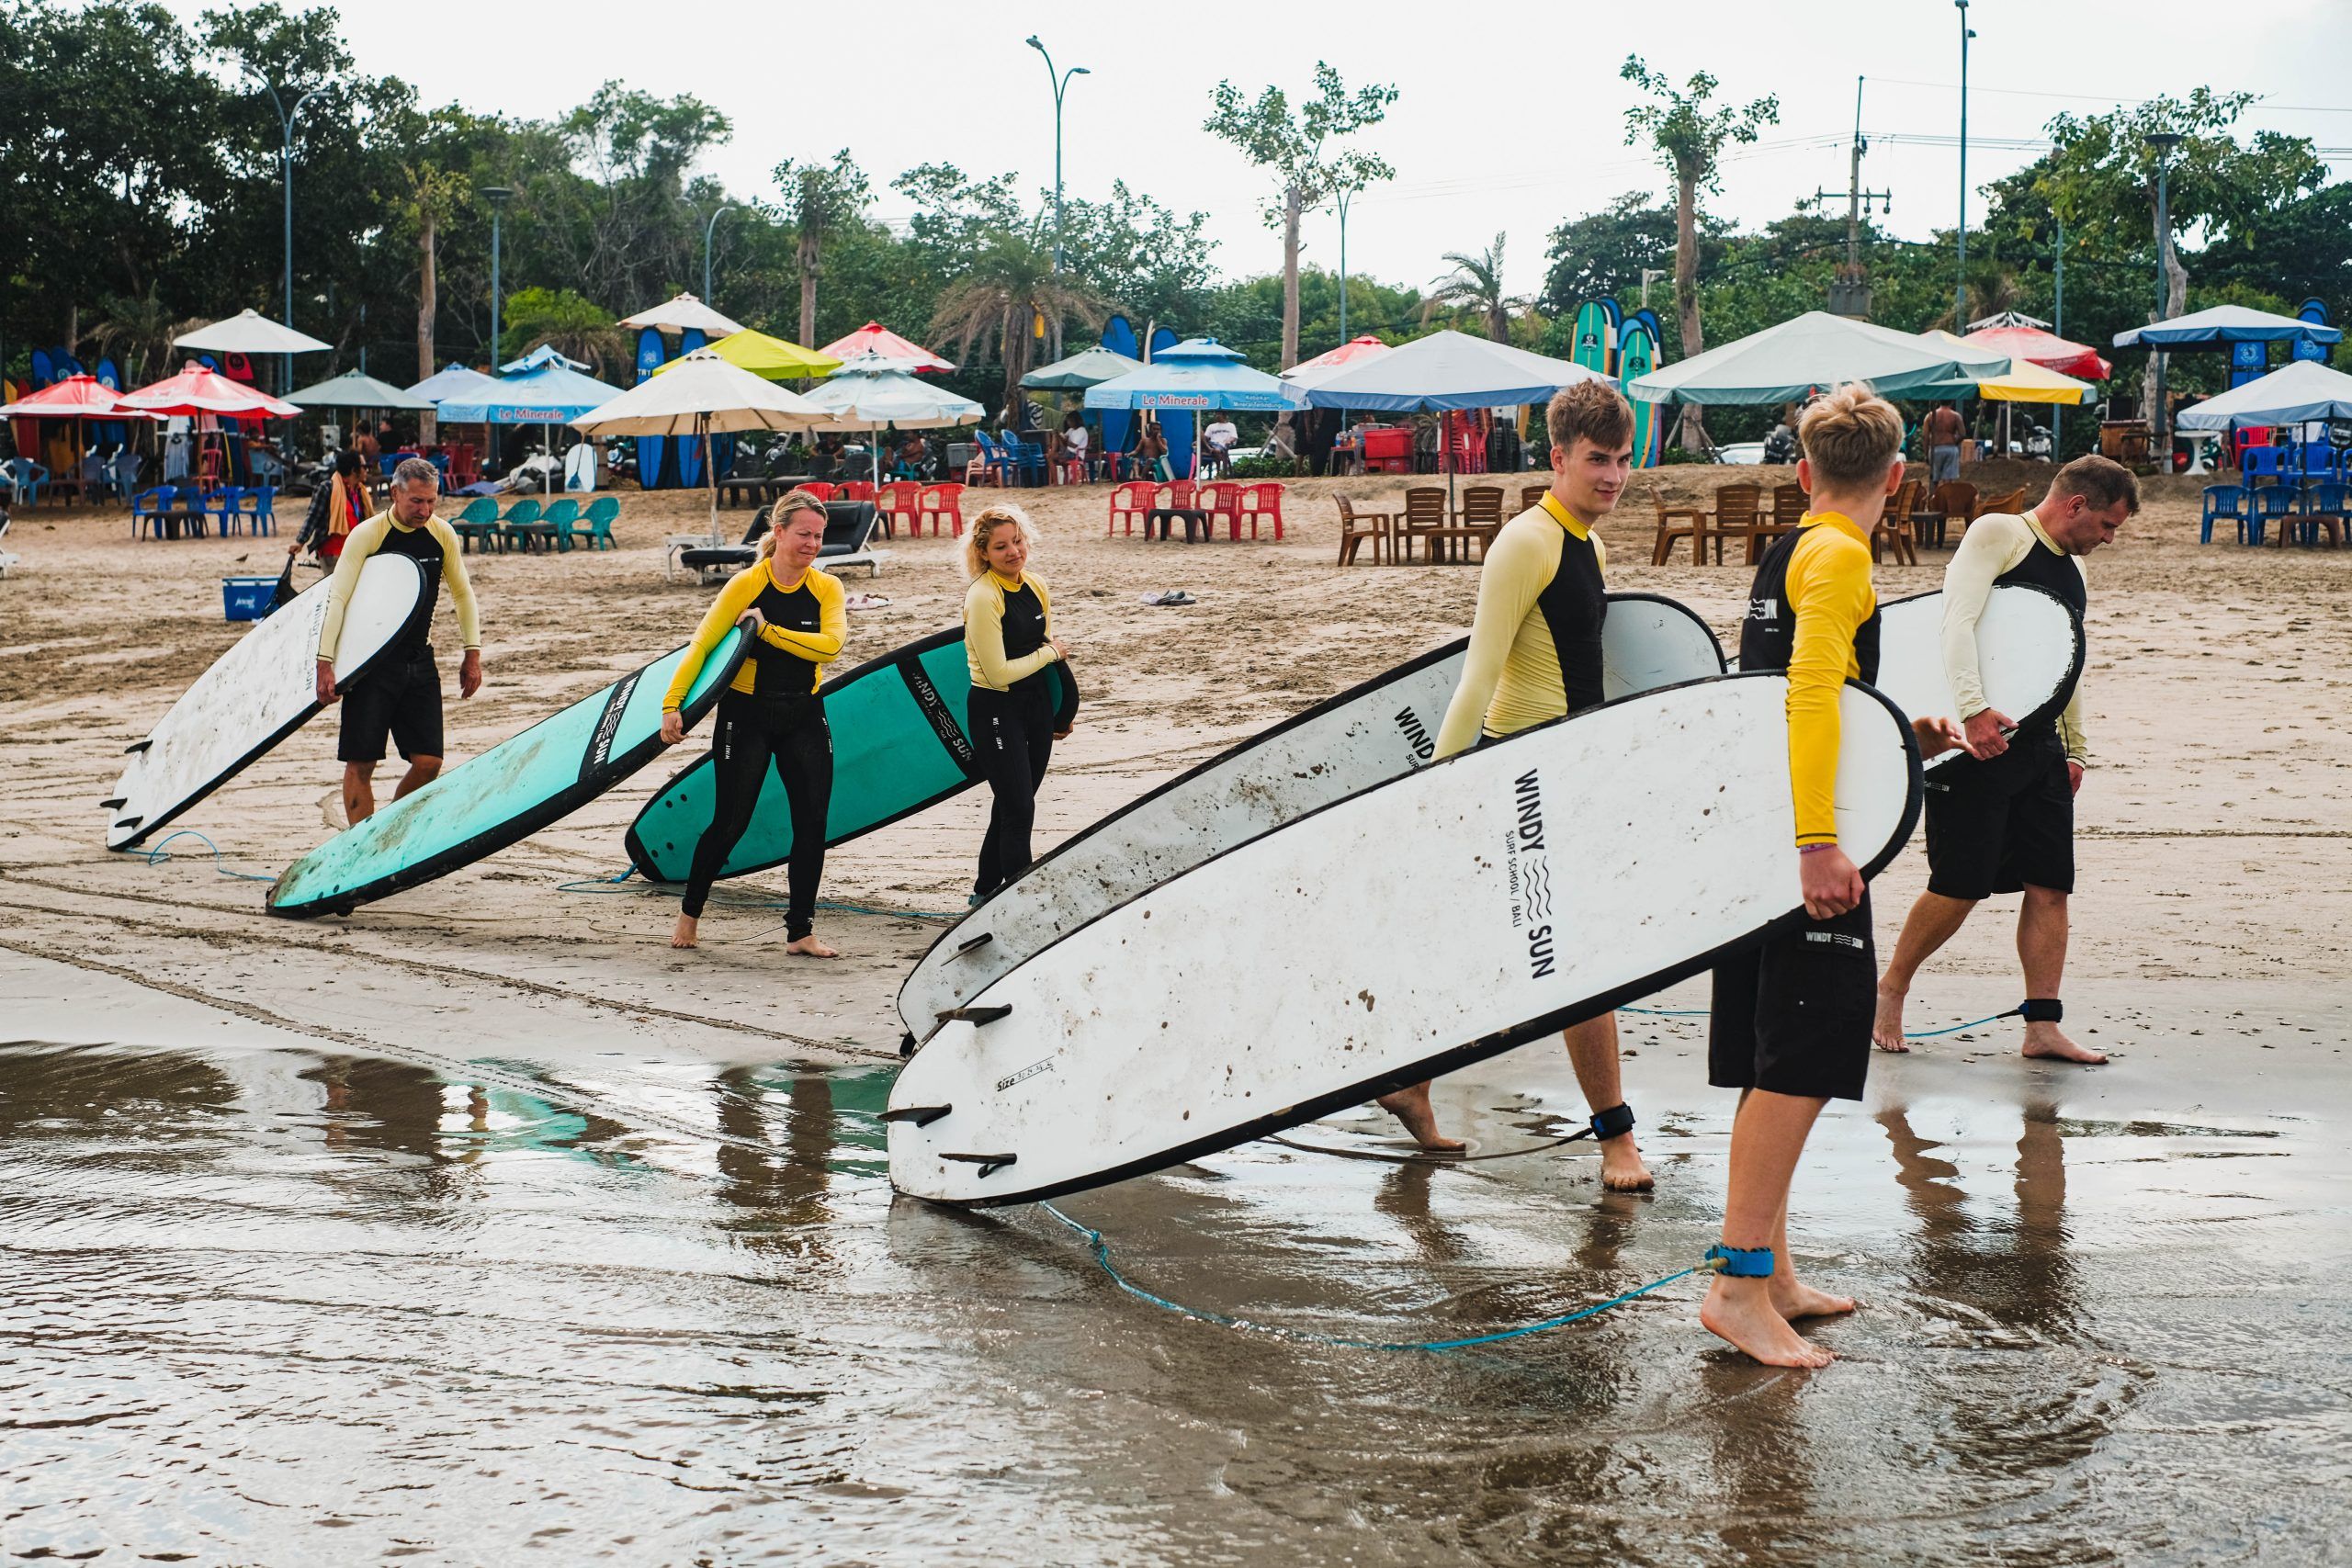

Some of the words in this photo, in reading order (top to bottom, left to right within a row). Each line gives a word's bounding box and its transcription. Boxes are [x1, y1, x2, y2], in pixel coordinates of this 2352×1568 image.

[1142, 394, 1156, 406] Le
[1159, 394, 1208, 407] Minerale
[499, 408, 511, 419] Le
[514, 408, 563, 420] Minerale
[613, 675, 639, 711] WINDY
[1394, 705, 1435, 760] WIND
[594, 738, 610, 764] SUN
[1406, 753, 1419, 770] SUR
[1514, 768, 1545, 852] WINDY
[1505, 830, 1516, 855] SURF
[1508, 857, 1520, 896] SCHOOL
[1511, 905, 1522, 928] BALI
[1528, 924, 1555, 980] SUN
[1805, 931, 1833, 943] WINDY
[1851, 937, 1864, 950] SUN
[997, 1077, 1015, 1092] Size
